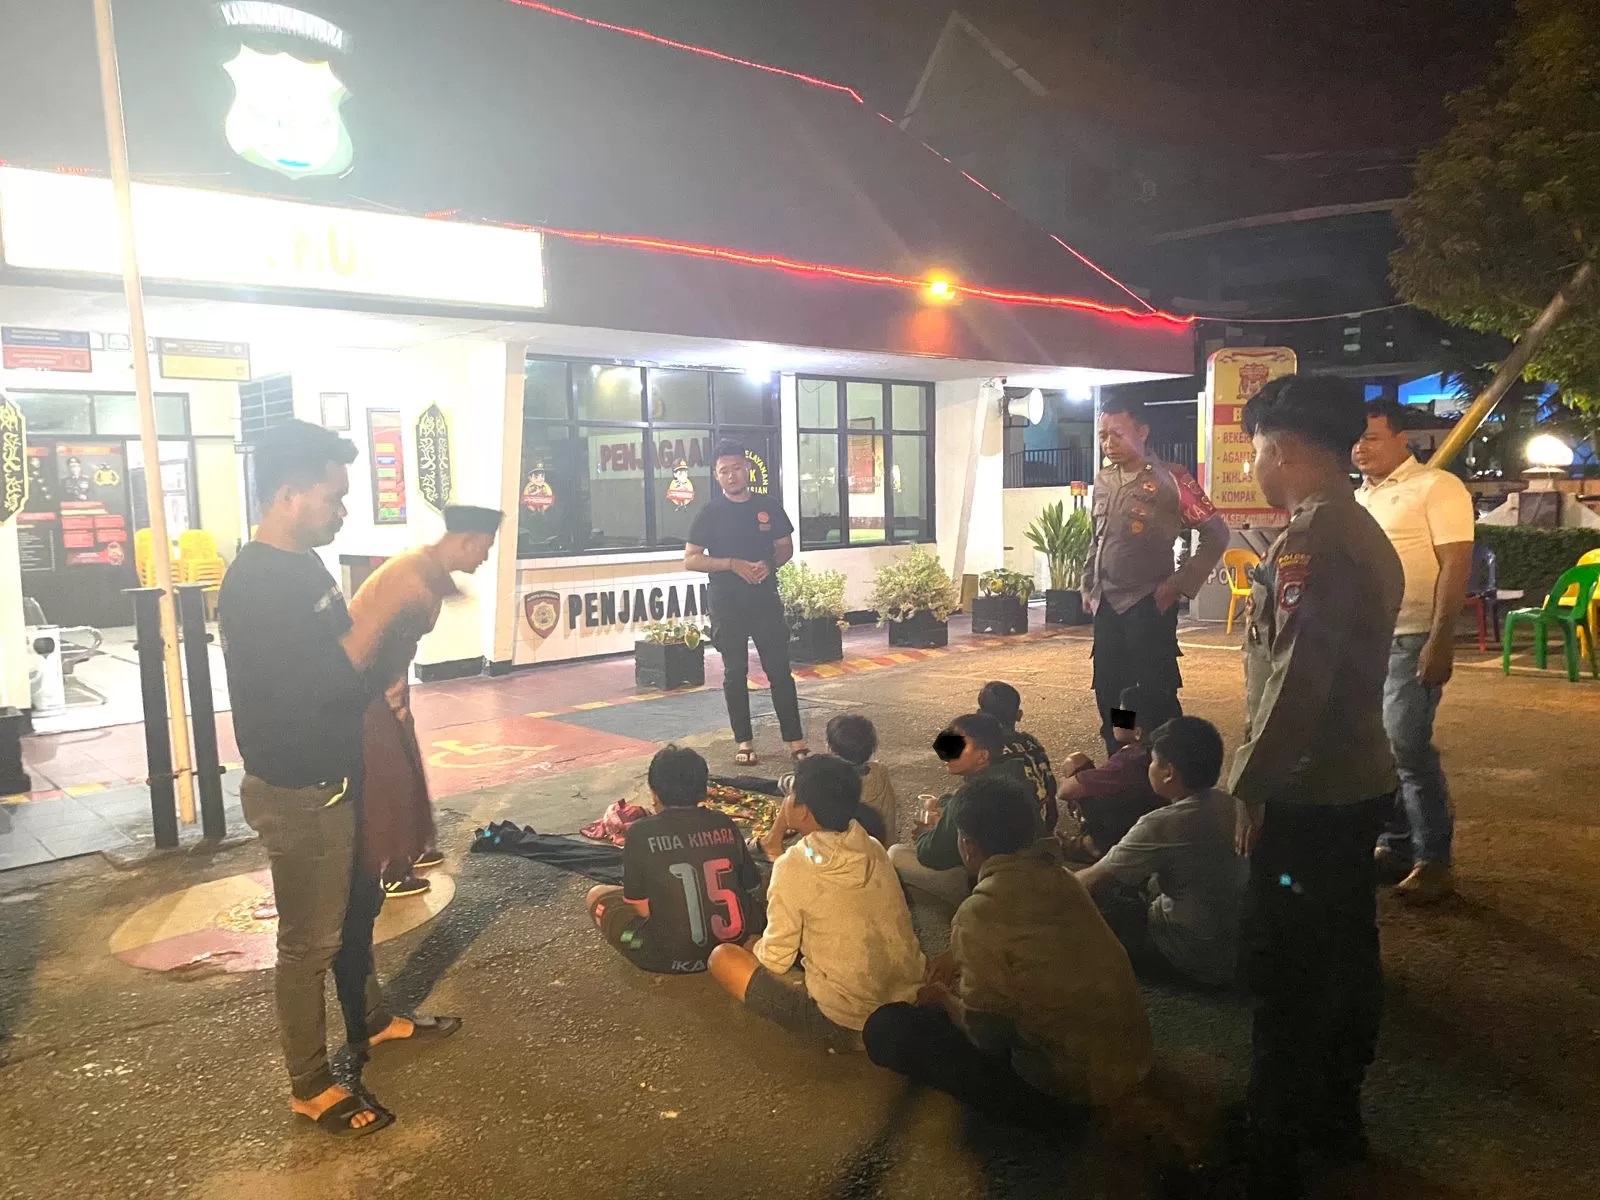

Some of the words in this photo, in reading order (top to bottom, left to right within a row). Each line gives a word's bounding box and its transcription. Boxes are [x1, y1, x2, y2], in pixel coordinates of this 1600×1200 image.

[1221, 471, 1254, 484] IKHLAS
[1221, 490, 1257, 503] KOMPAK
[648, 835, 684, 853] FIDA
[669, 858, 745, 947] 15
